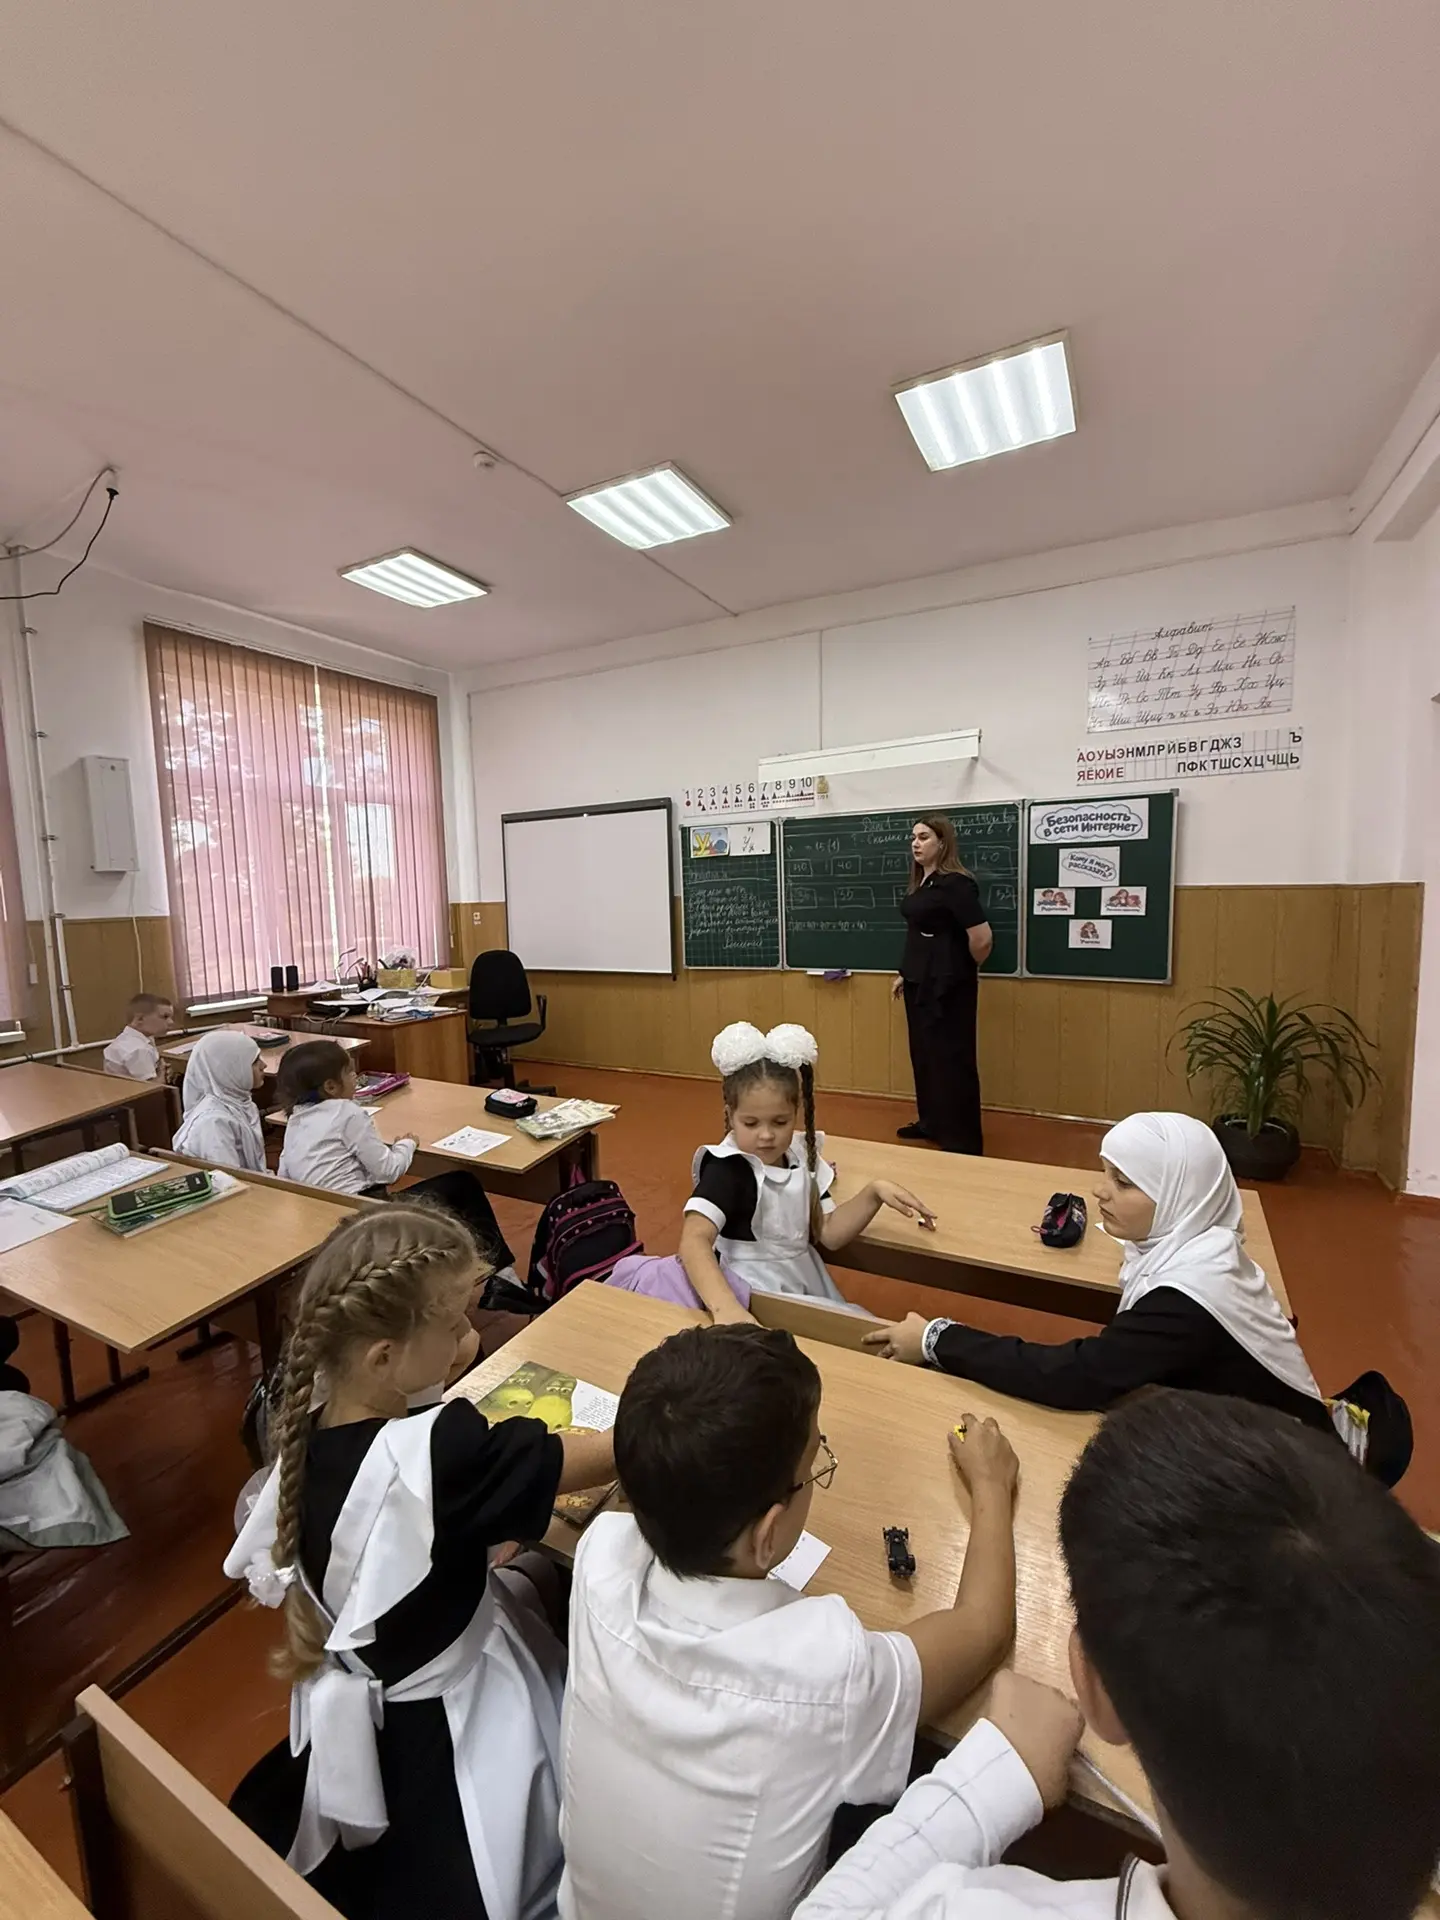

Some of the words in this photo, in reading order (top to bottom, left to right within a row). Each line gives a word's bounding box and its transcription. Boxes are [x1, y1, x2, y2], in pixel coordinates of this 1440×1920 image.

[1151, 621, 1214, 641] Алфавит
[697, 788, 704, 798] 2
[710, 787, 716, 797] 3
[722, 786, 728, 795] 4
[735, 784, 742, 794] 5
[748, 783, 755, 793] 6
[775, 780, 782, 790] 8
[789, 779, 796, 788] 9
[800, 776, 812, 787] 10
[1046, 812, 1131, 828] Безопасность
[1043, 828, 1052, 837] в
[1053, 824, 1078, 834] сети
[1079, 822, 1139, 833] Интернет
[1070, 854, 1088, 863] Кому
[1095, 861, 1112, 872] могу
